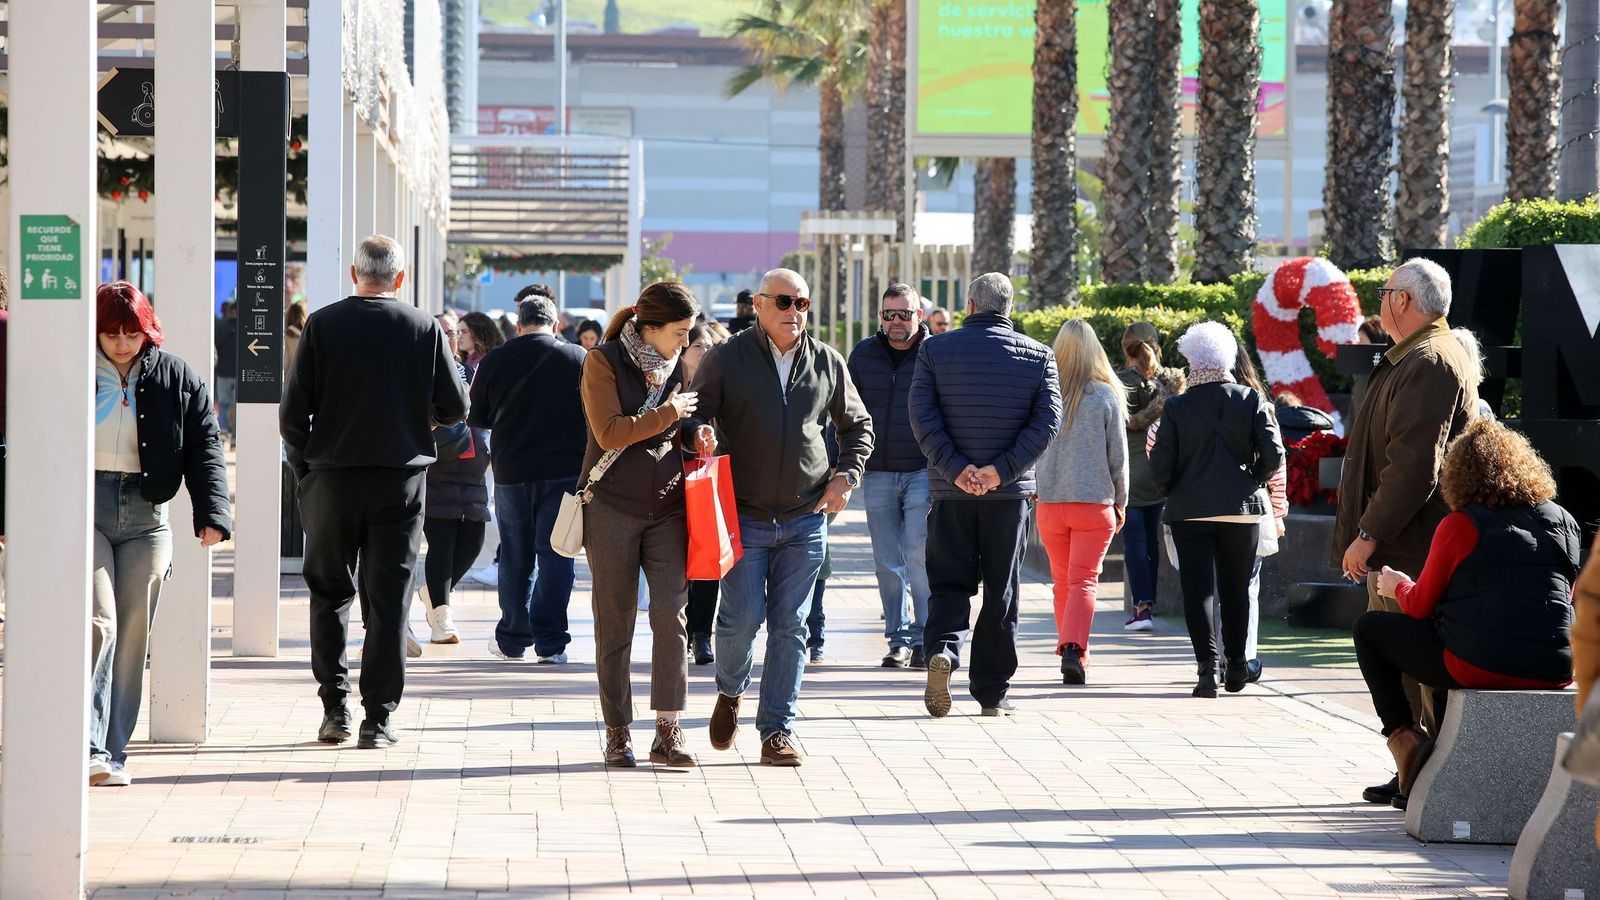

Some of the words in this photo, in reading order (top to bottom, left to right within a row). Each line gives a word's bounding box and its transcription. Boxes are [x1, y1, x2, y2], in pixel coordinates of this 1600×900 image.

[938, 3, 962, 17] de
[968, 2, 1035, 17] servici
[40, 235, 59, 243] QUE
[37, 244, 62, 252] TIENE
[26, 253, 74, 261] PRIORIDAD
